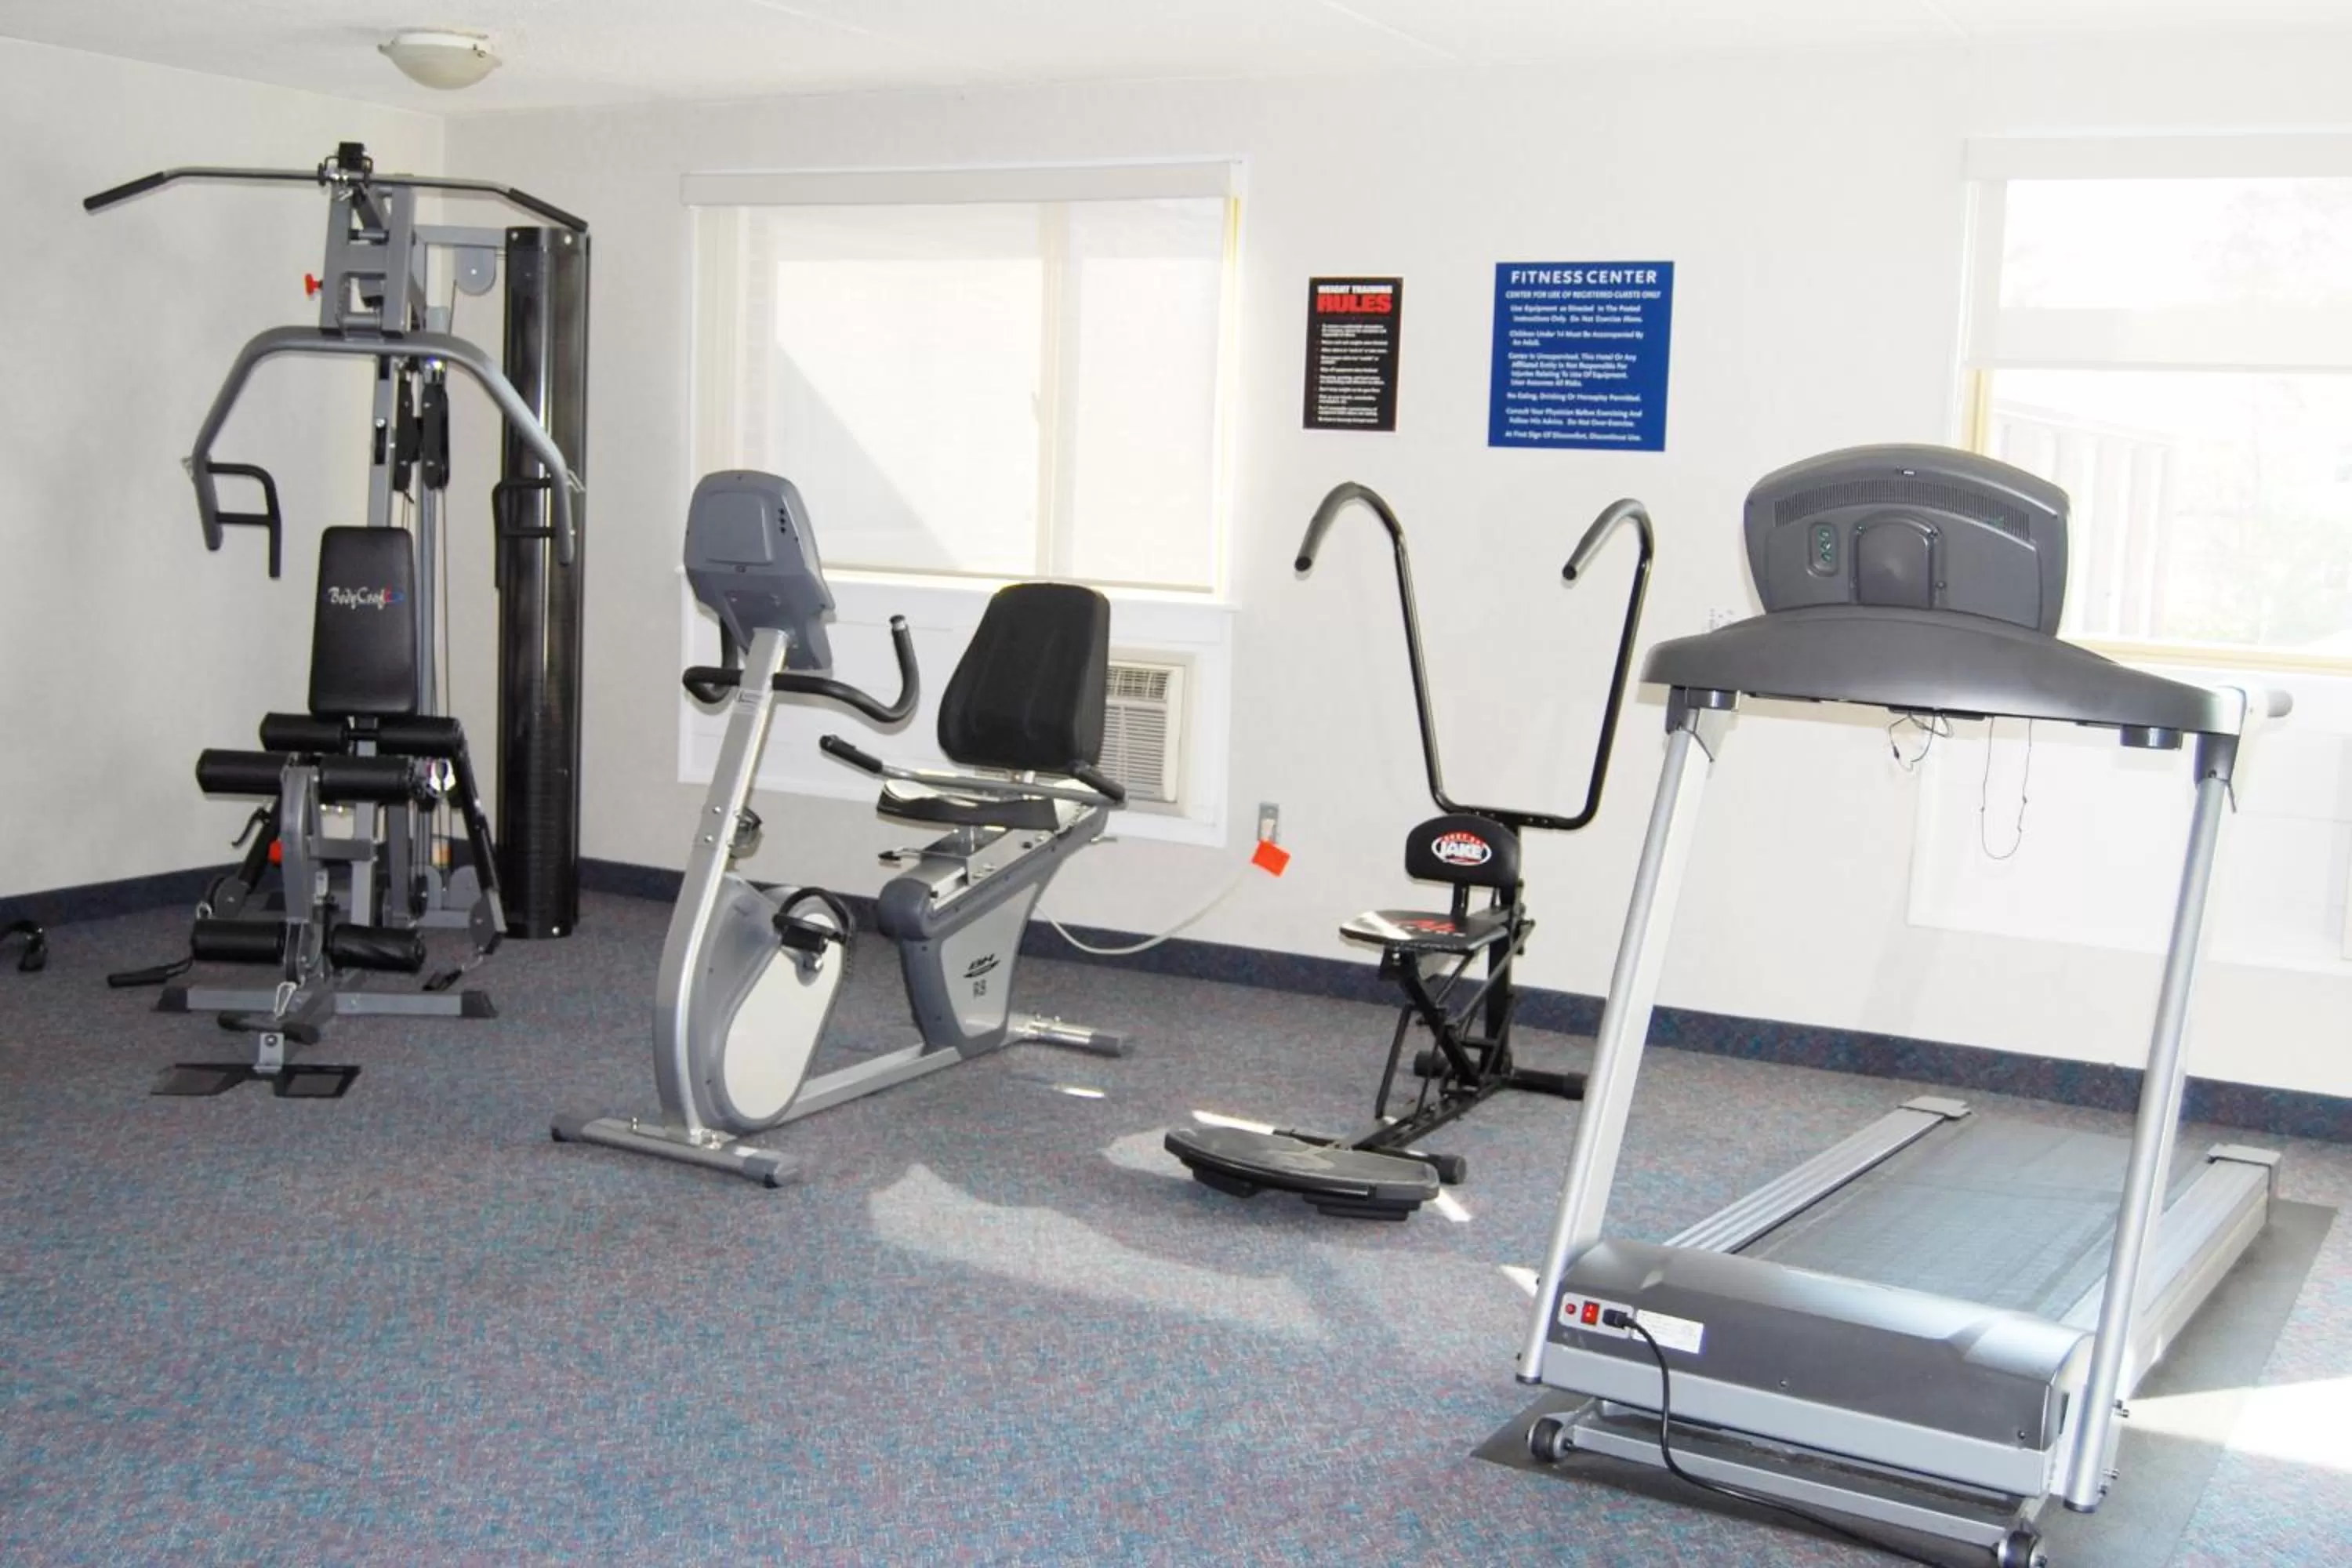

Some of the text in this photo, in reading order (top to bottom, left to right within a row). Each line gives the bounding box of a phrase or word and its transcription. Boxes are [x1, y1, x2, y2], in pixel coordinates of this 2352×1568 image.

[1510, 270, 1657, 285] FITNESS CENTER
[1505, 290, 1532, 299] CENTER
[1533, 290, 1546, 299] FOR
[1547, 290, 1560, 299] USE
[1561, 290, 1572, 299] OF
[1641, 290, 1661, 299] ONLY
[1316, 293, 1393, 314] RULES
[1508, 329, 1535, 338] Children
[1536, 329, 1555, 338] Under
[1441, 840, 1482, 861] JAKE
